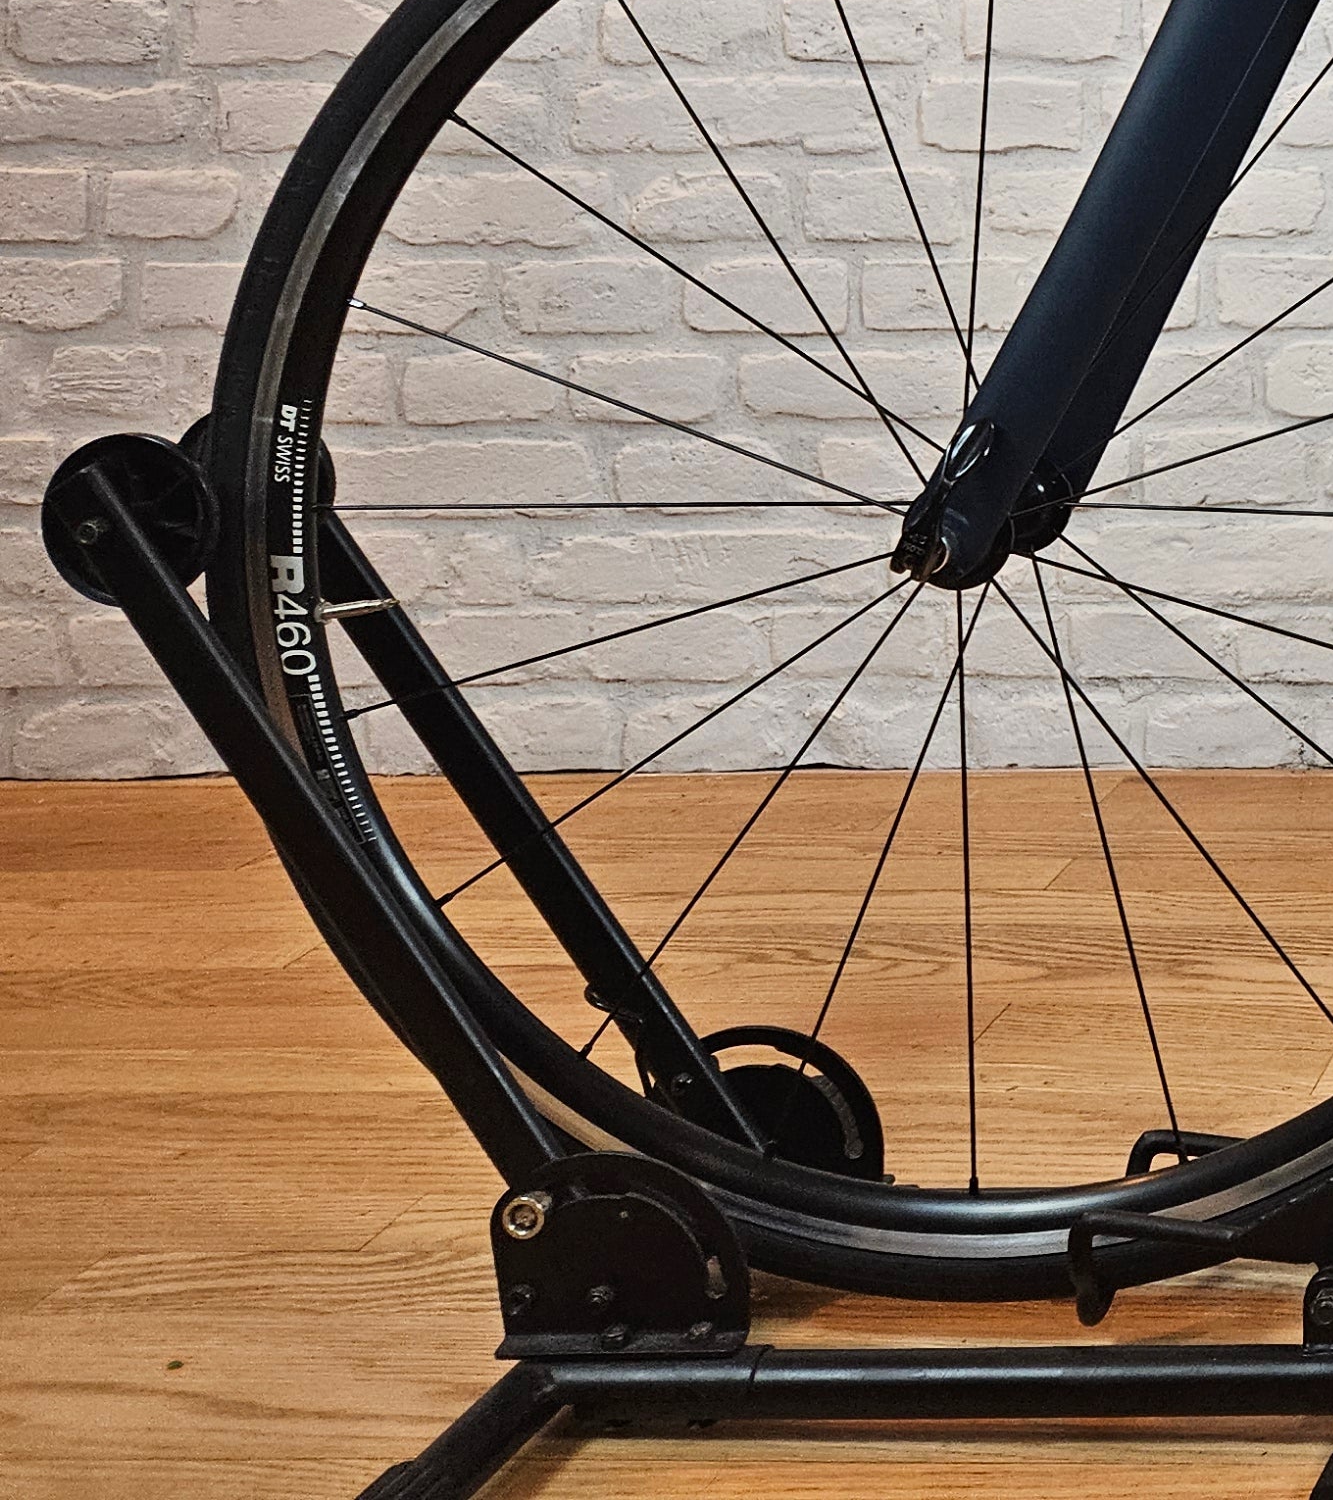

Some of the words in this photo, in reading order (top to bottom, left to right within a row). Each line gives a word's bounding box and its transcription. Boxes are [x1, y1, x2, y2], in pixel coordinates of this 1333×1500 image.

[280, 404, 297, 432] DT
[274, 435, 293, 482] SWISS
[270, 555, 317, 675] R460
